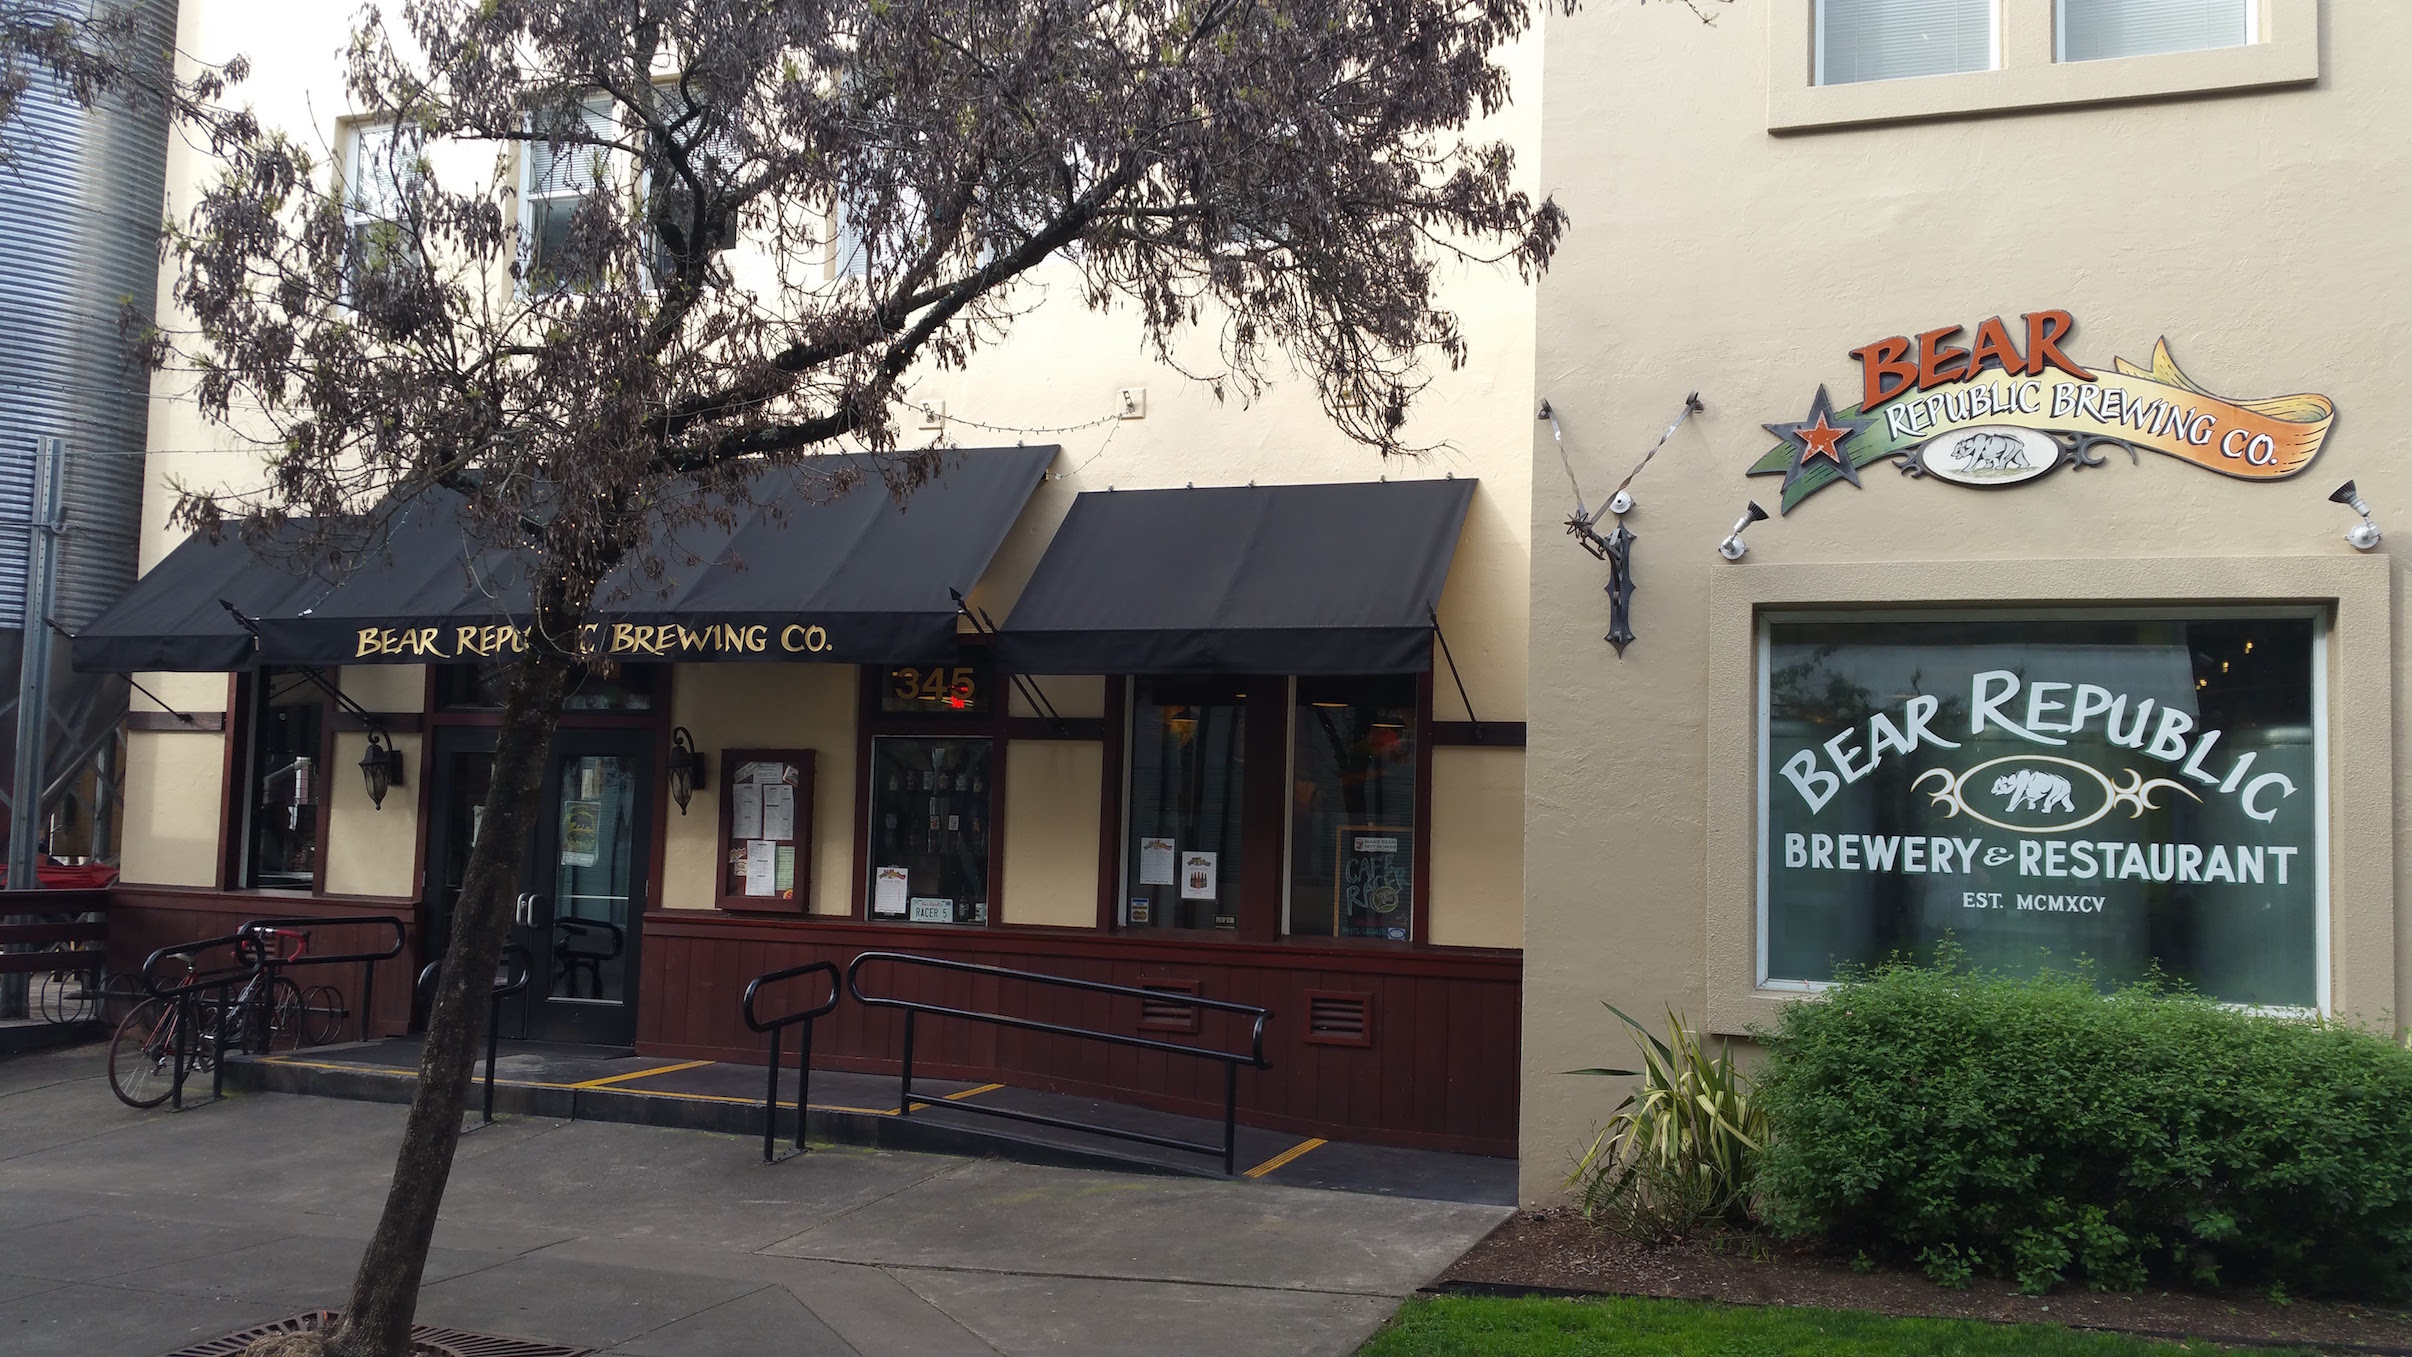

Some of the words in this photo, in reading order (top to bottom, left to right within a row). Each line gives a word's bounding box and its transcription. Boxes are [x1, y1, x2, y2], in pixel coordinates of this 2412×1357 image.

[1849, 309, 2099, 415] BEAR
[1884, 380, 2042, 441] REPUBLIC
[2050, 382, 2218, 446] BREWING
[2220, 428, 2278, 466] CO.
[355, 627, 450, 658] BEAR
[456, 623, 599, 657] REPUC
[608, 623, 768, 656] BREWING
[781, 624, 833, 652] CO.
[896, 667, 975, 699] 345
[1779, 694, 1961, 816] BEAR
[1971, 670, 2298, 824] REPUBLIC
[1785, 832, 1983, 874] BREWERY
[1983, 847, 2015, 867] &
[2019, 839, 2298, 884] RESTAURANT
[915, 907, 939, 918] RACER
[942, 908, 948, 919] 5
[1963, 892, 2004, 909] EST.
[2016, 894, 2106, 913] MCMXCV
